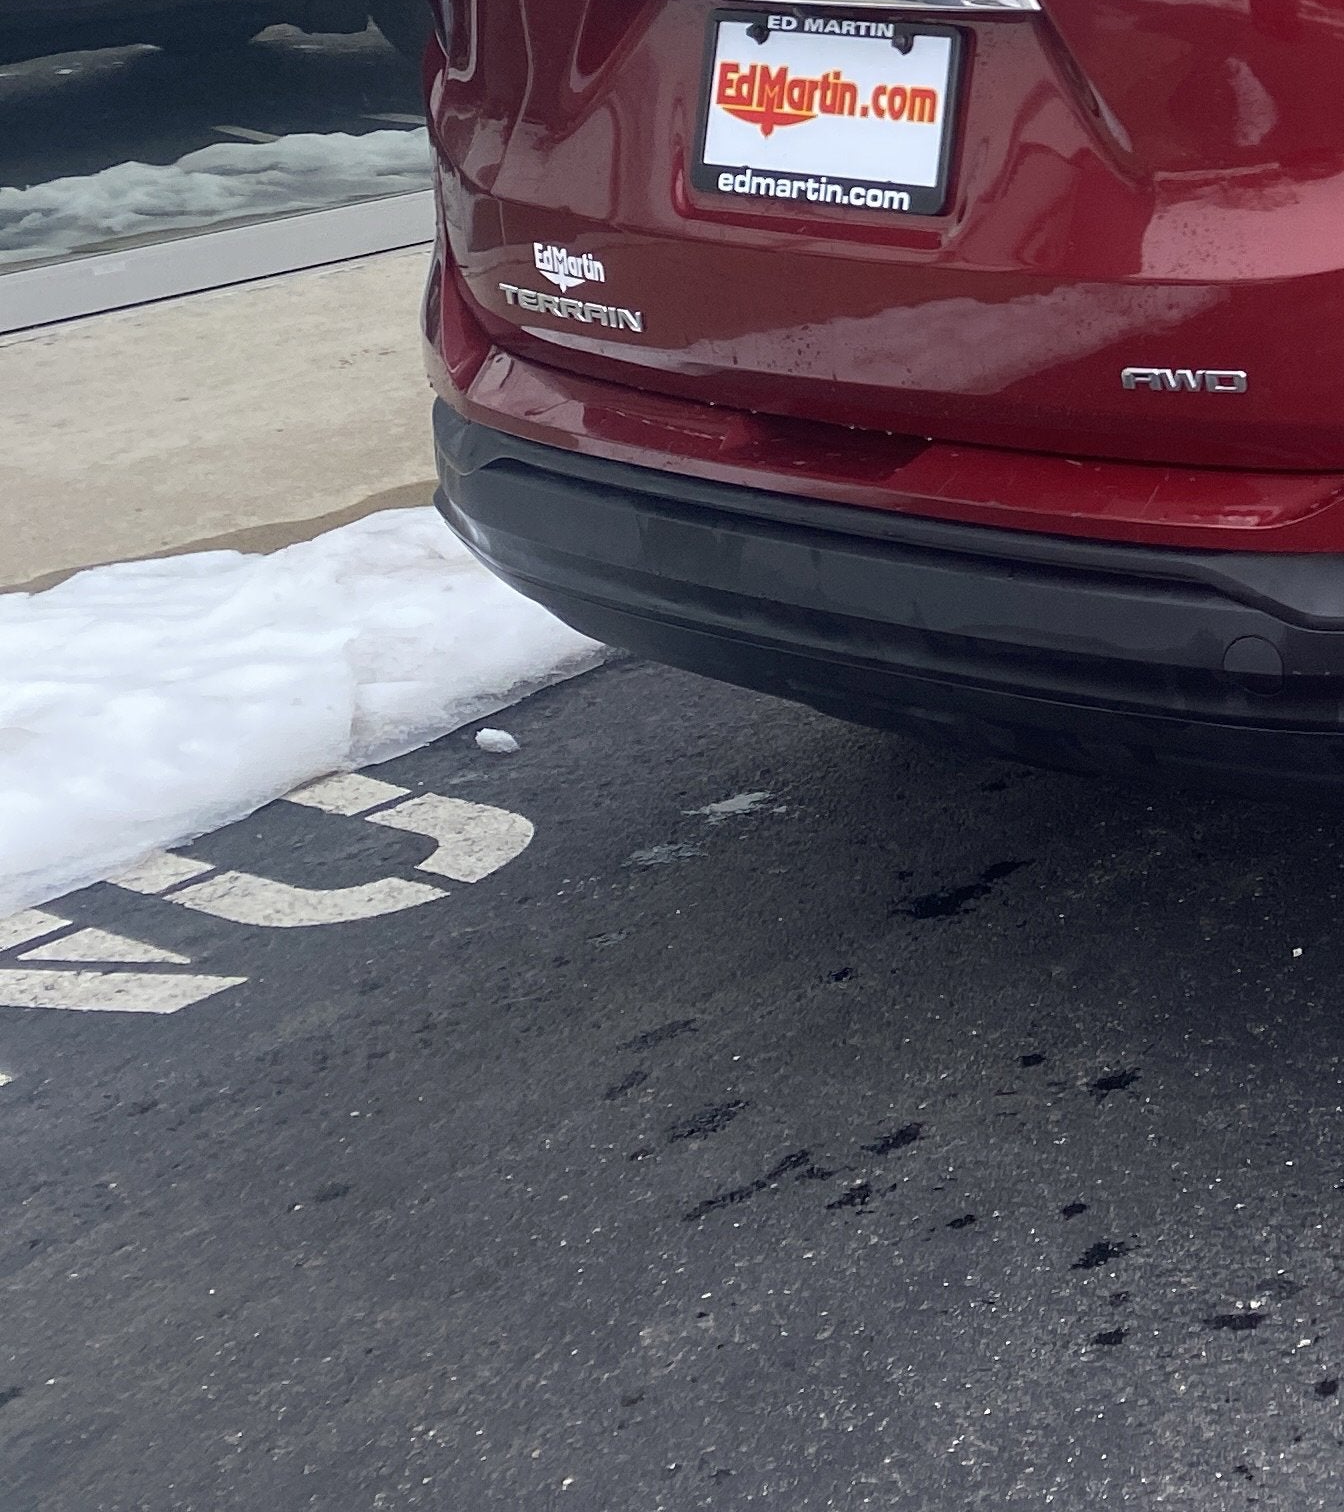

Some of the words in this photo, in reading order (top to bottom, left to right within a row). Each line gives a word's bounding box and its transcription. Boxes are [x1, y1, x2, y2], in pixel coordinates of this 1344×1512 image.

[767, 15, 797, 30] ED
[803, 17, 895, 38] MARTIN
[716, 61, 938, 124] EdMartin.com
[717, 169, 910, 211] edmartin.com
[533, 242, 605, 283] EdMartin
[498, 282, 643, 333] TERRAIN
[1121, 367, 1247, 394] AWD
